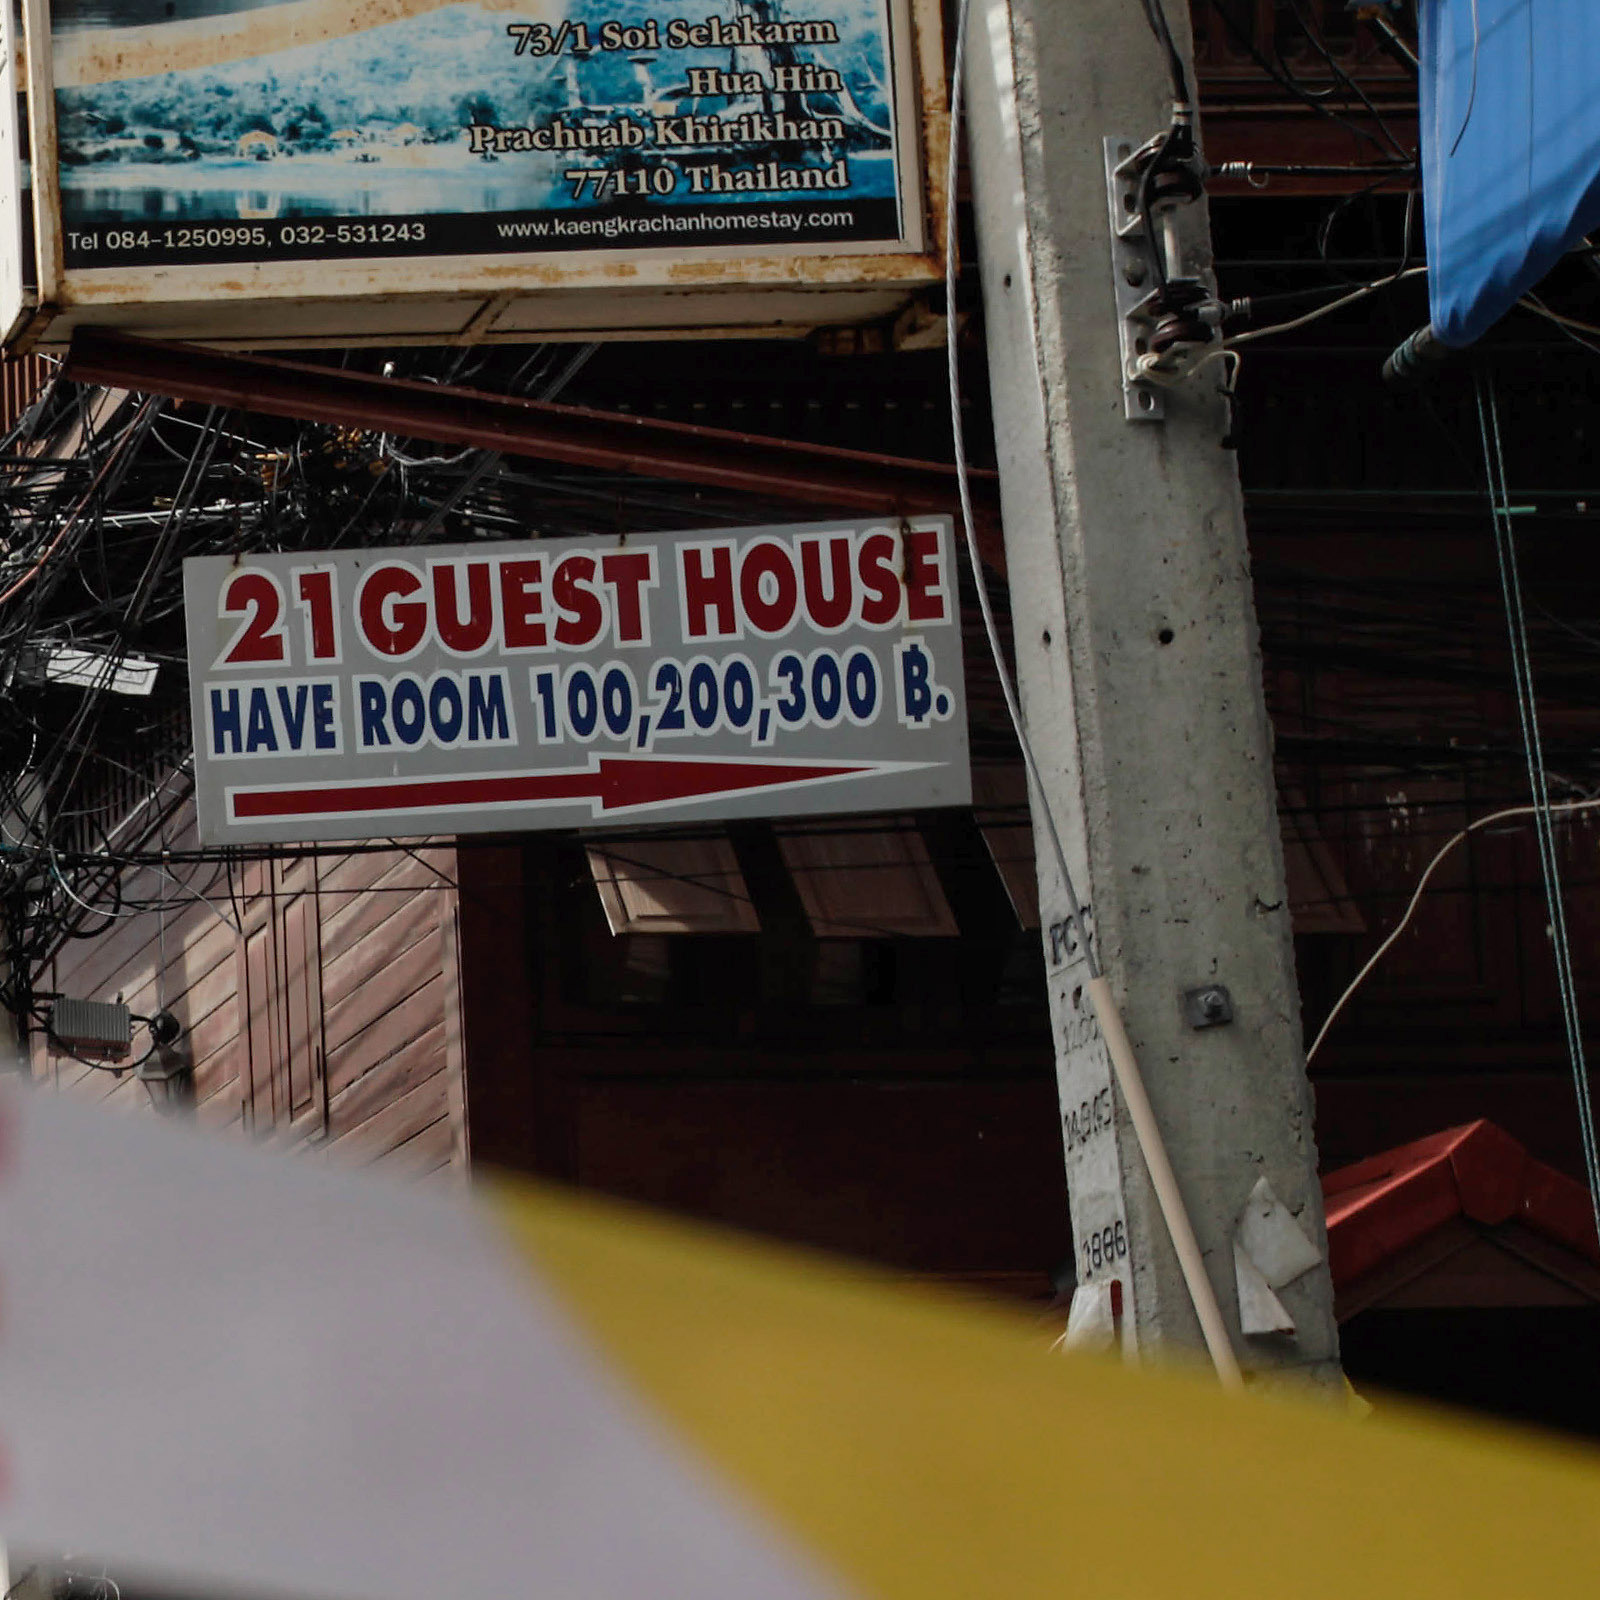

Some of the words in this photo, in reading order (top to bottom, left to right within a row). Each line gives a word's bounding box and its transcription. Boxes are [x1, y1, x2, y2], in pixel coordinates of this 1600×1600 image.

[507, 21, 593, 56] 73/1
[601, 20, 661, 51] Soi
[666, 16, 839, 49] Selakarm
[687, 67, 764, 97] Hua
[772, 64, 842, 94] Hin
[470, 118, 644, 154] Prachuab
[653, 115, 845, 147] Khirikhan
[565, 167, 675, 200] 77110
[684, 160, 850, 195] Thailand
[67, 231, 98, 250] Tel
[105, 227, 273, 250] 084-1250995,
[280, 223, 427, 246] 032-531243
[497, 209, 854, 238] www.kaengkrachanhomestay.com
[224, 569, 341, 665] 21
[359, 546, 654, 656] GUEST
[683, 529, 948, 640] HOUSE
[210, 679, 340, 755] HAVE
[360, 672, 512, 750] ROOM
[535, 650, 881, 752] 100,200,300
